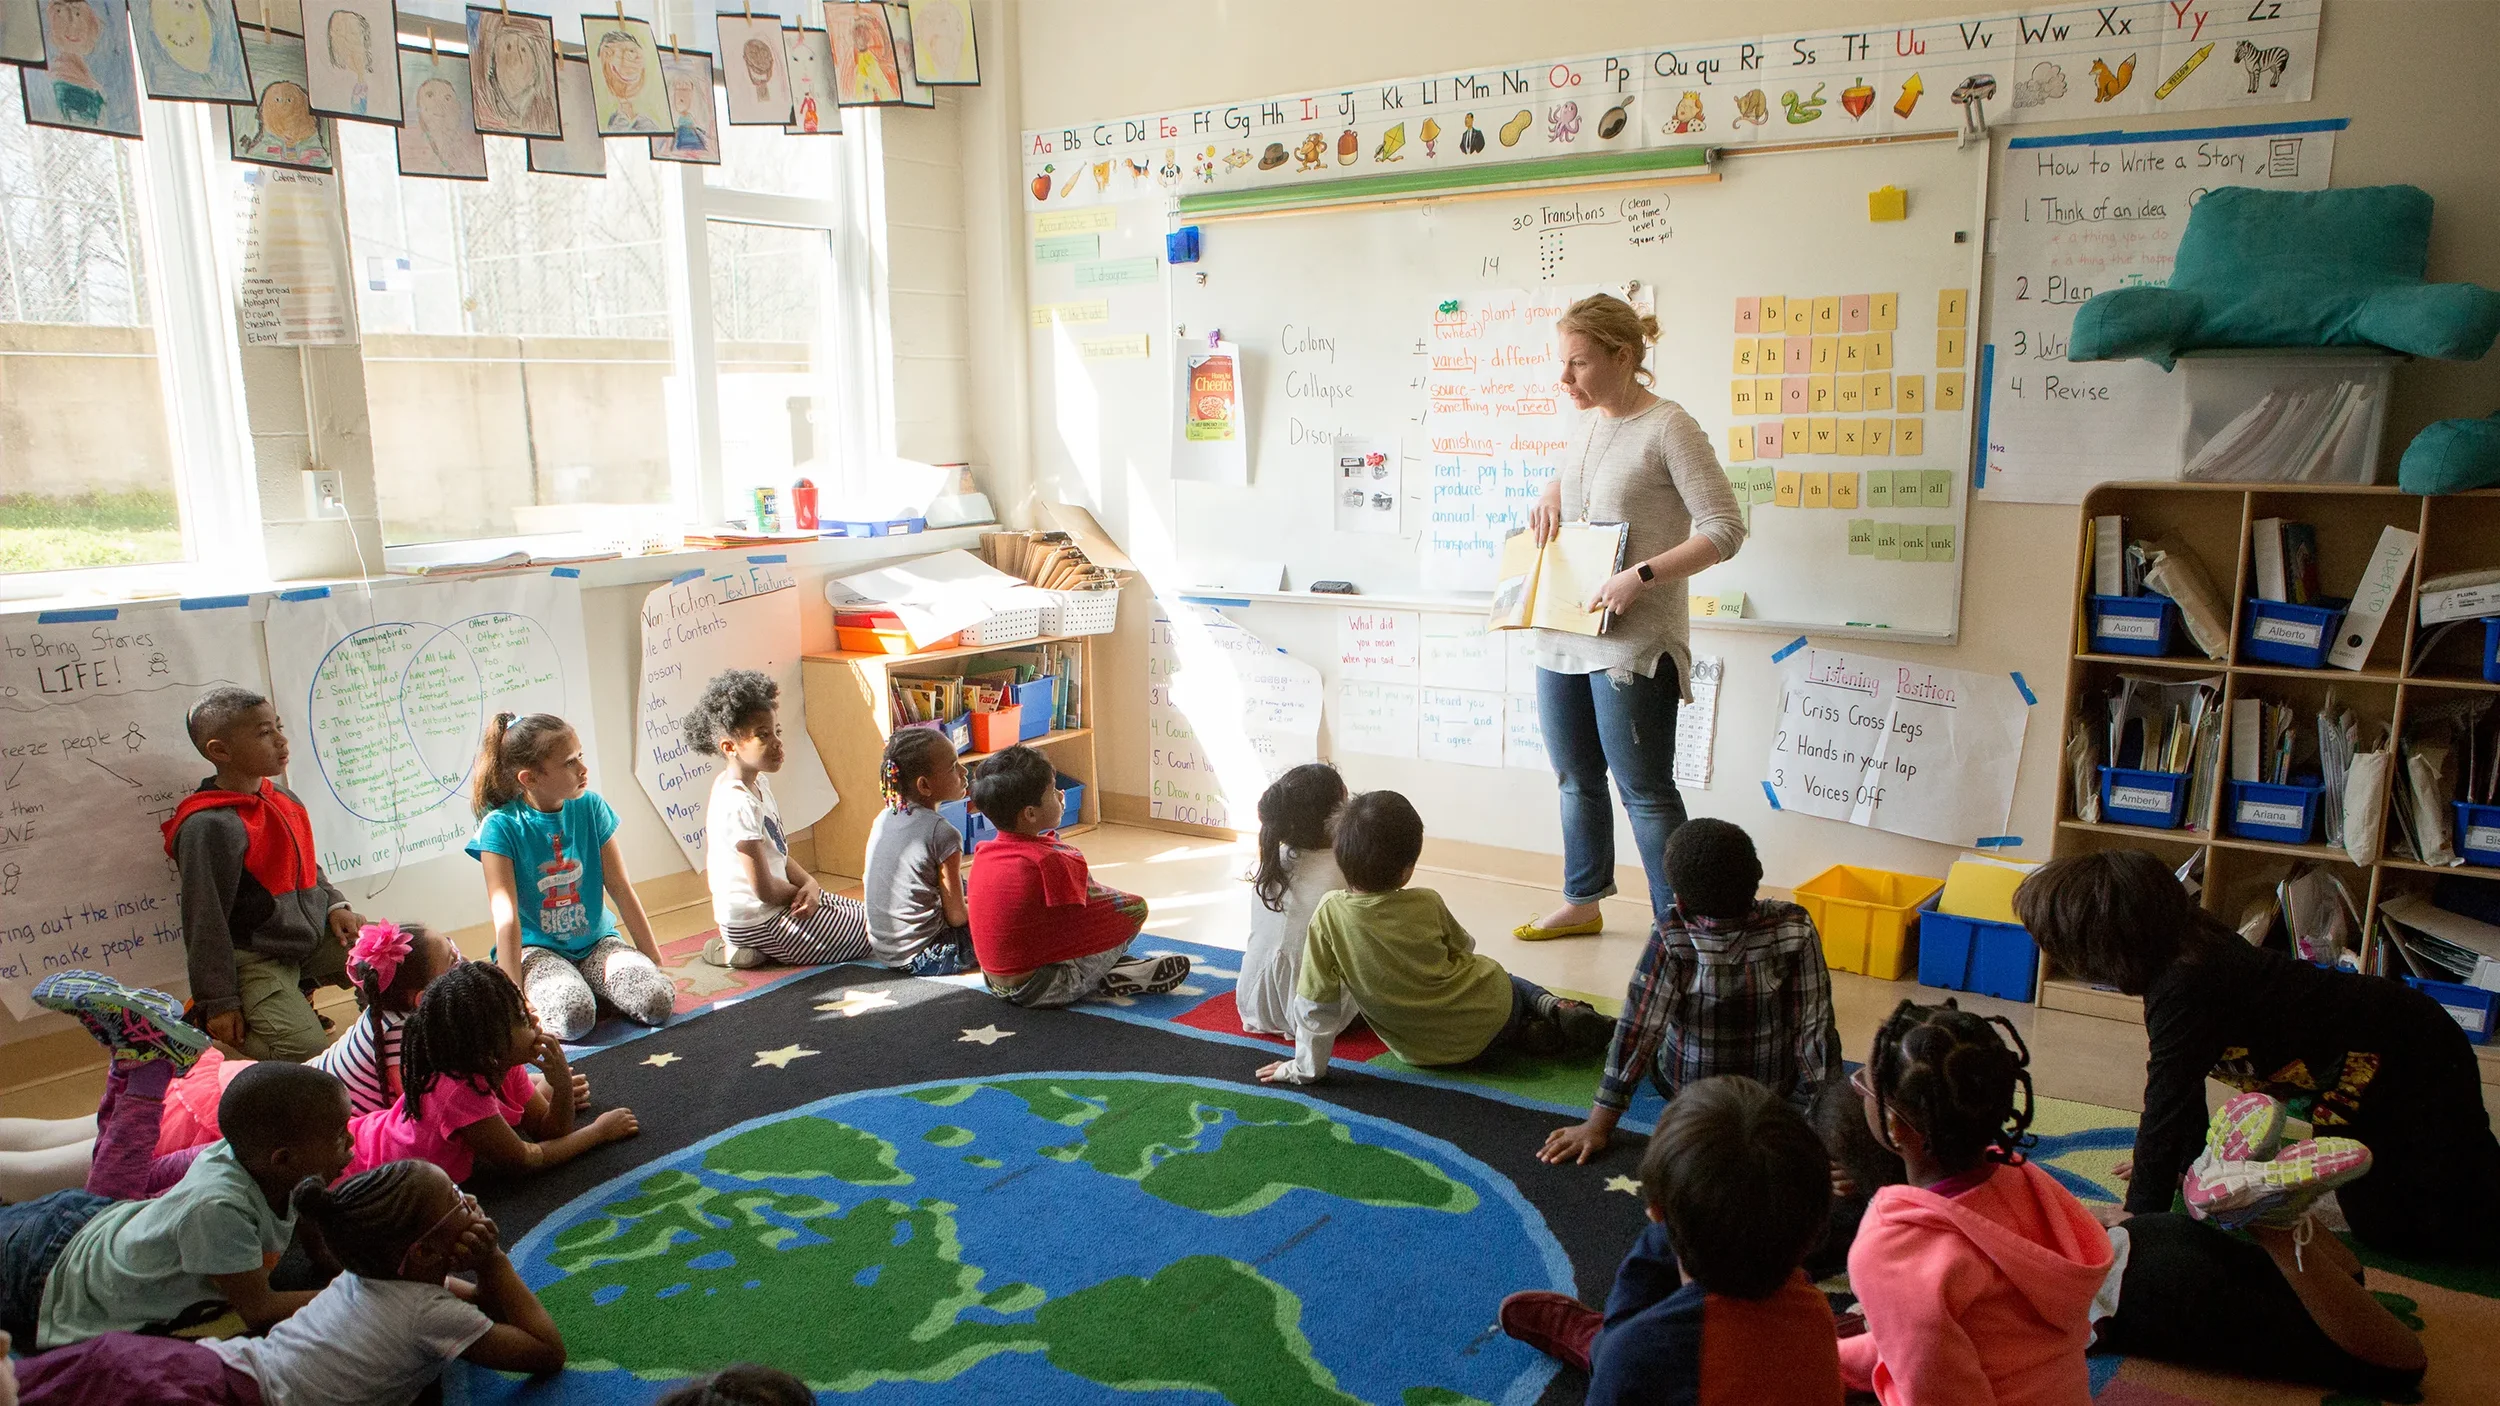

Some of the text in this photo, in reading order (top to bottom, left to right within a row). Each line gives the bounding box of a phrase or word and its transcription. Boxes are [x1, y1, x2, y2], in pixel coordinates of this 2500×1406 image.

[1033, 0, 2281, 155] Aa Bb Cc Dd Ee Ff Gg Hh Ii Jj Kk Ll Mm Nn Oo Pp Qu qu Rr Ss Tt Uu Vv Ww Xx Yy Zz
[2037, 143, 2244, 177] How to Write a Story
[1512, 215, 1533, 231] 30
[1540, 203, 1605, 225] Transitions
[1628, 208, 1660, 222] on time
[2041, 197, 2166, 220] Think of an idea
[1633, 219, 1654, 233] level
[1629, 236, 1655, 247] square
[1483, 257, 1499, 277] 14
[2049, 276, 2093, 300] Plan
[245, 319, 282, 329] Chestnut
[1482, 301, 1562, 329] plant grown
[248, 332, 278, 343] Ebony
[1282, 324, 1335, 364] Colony
[1432, 343, 1552, 374] variety different
[1767, 347, 1856, 363] h j k
[1195, 377, 1232, 391] Cheerios
[1286, 371, 1354, 408] Collapse
[1431, 378, 1545, 400] source where you
[2046, 376, 2109, 400] Revise
[1737, 388, 1857, 401] m n o p qu
[1433, 396, 1550, 417] something you need
[1432, 431, 1493, 455] vanishing
[1817, 432, 1830, 440] w
[1478, 460, 1513, 484] pay to
[1434, 479, 1539, 503] produce make
[1752, 480, 1772, 492] ung
[1781, 485, 1793, 494] ch
[1811, 486, 1821, 495] th
[1838, 486, 1850, 495] ck
[1873, 485, 1886, 493] an
[1929, 483, 1943, 493] all
[1851, 533, 1951, 548] ank ink onk unk
[712, 574, 746, 600] Text
[750, 568, 795, 595] Features
[1721, 603, 1740, 613] ong
[469, 615, 511, 628] Other Birds
[677, 612, 727, 643] Contents
[1348, 615, 1394, 631] What did
[2114, 623, 2142, 633] Aaron
[349, 628, 407, 647] Hummingbirds
[2268, 625, 2306, 641] Alberto
[6, 627, 153, 662] to Bring Stories
[1356, 639, 1395, 650] you mean
[1342, 655, 1376, 668] when you
[38, 656, 121, 694] LIFE!
[1809, 650, 1956, 702] Listening Position
[331, 681, 368, 697] Smallest
[1435, 694, 1484, 712] heard you
[1166, 720, 1193, 738] Count
[1424, 713, 1492, 726] say and
[1802, 697, 1923, 742] Criss Cross Legs
[62, 728, 110, 760] people
[1447, 736, 1472, 751] agree
[1168, 753, 1195, 770] Count
[1798, 735, 1916, 781] Hands in your lap
[442, 775, 460, 785] Both
[658, 761, 712, 791] Captions
[1168, 781, 1189, 799] Draw
[1804, 775, 1885, 809] Voices Off
[2119, 793, 2161, 808] Amberly
[667, 801, 700, 821] Maps
[1175, 805, 1228, 827] 100 chart
[2253, 808, 2286, 822] Ariana
[324, 824, 465, 875] How are hummingbirds
[42, 907, 72, 934] out
[81, 903, 108, 924] the
[43, 928, 144, 970] make people
